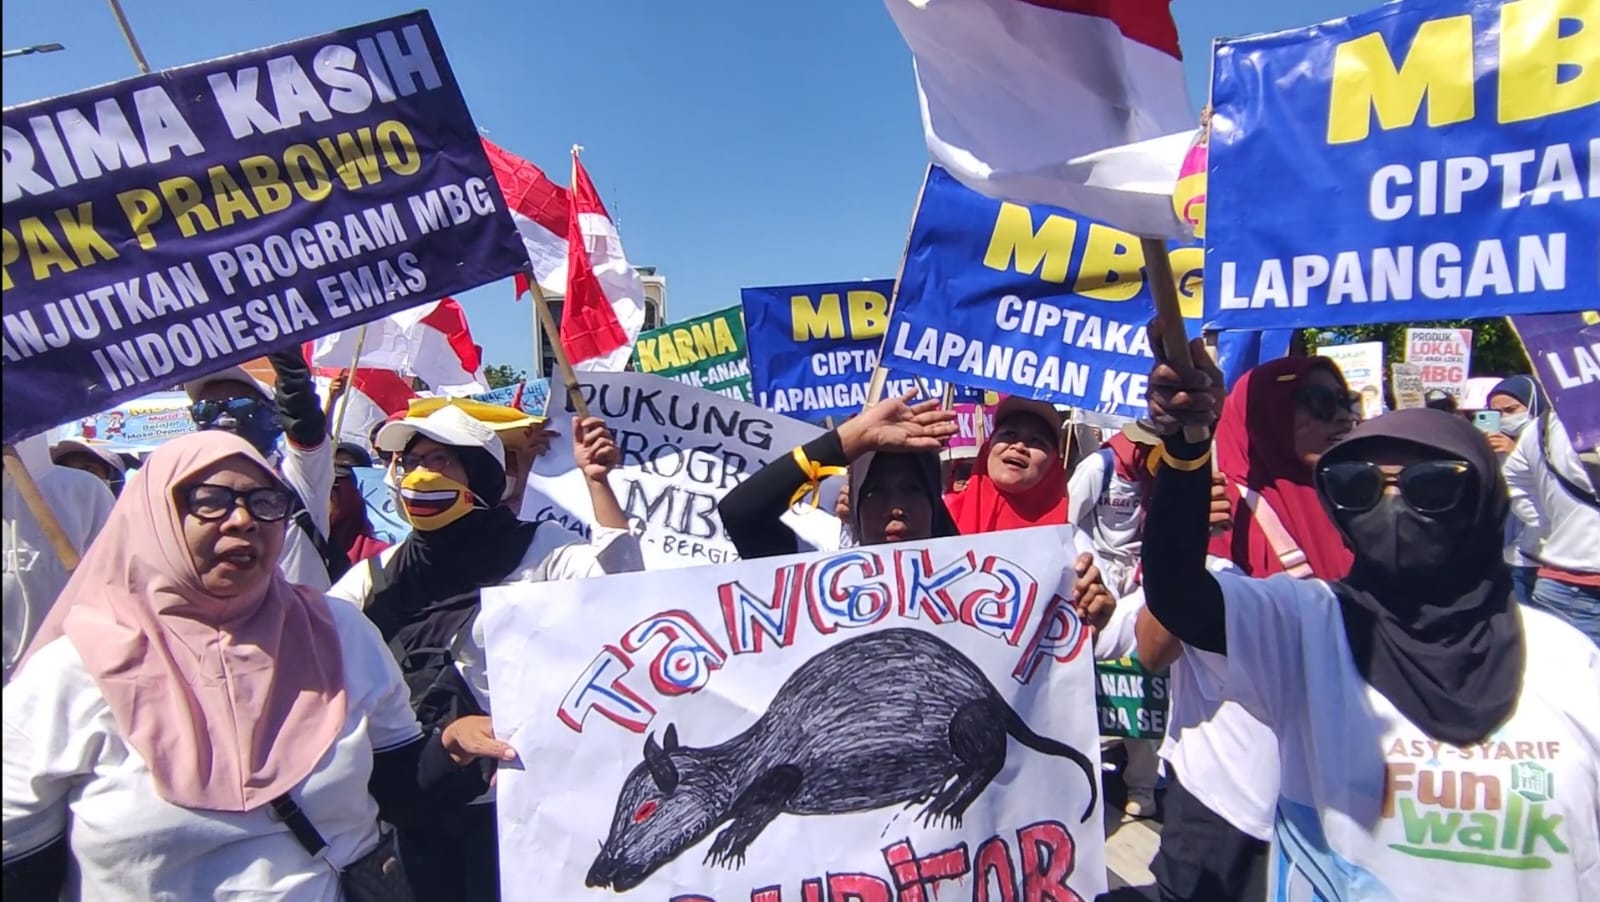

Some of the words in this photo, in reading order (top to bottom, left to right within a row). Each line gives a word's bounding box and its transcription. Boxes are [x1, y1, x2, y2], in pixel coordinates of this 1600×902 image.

[3, 86, 205, 203] RIMA
[208, 24, 442, 139] KASIH
[117, 120, 422, 251] PRABOWO
[1369, 137, 1600, 221] CIPTA
[210, 201, 405, 295] PROGRAM
[420, 176, 495, 235] MBG
[1219, 232, 1567, 311] LAPANGAN
[93, 300, 316, 392] INDONESIA
[317, 252, 427, 319] EMAS
[636, 316, 738, 374] KARNA
[790, 290, 889, 342] MB
[1411, 342, 1464, 356] LOKAL
[1412, 332, 1452, 342] PRODUK
[893, 322, 1090, 397] LAPANGAN
[565, 383, 774, 451] DUKUNG
[624, 478, 732, 542] MB
[1136, 707, 1168, 732] SE
[1382, 762, 1502, 819] Fun
